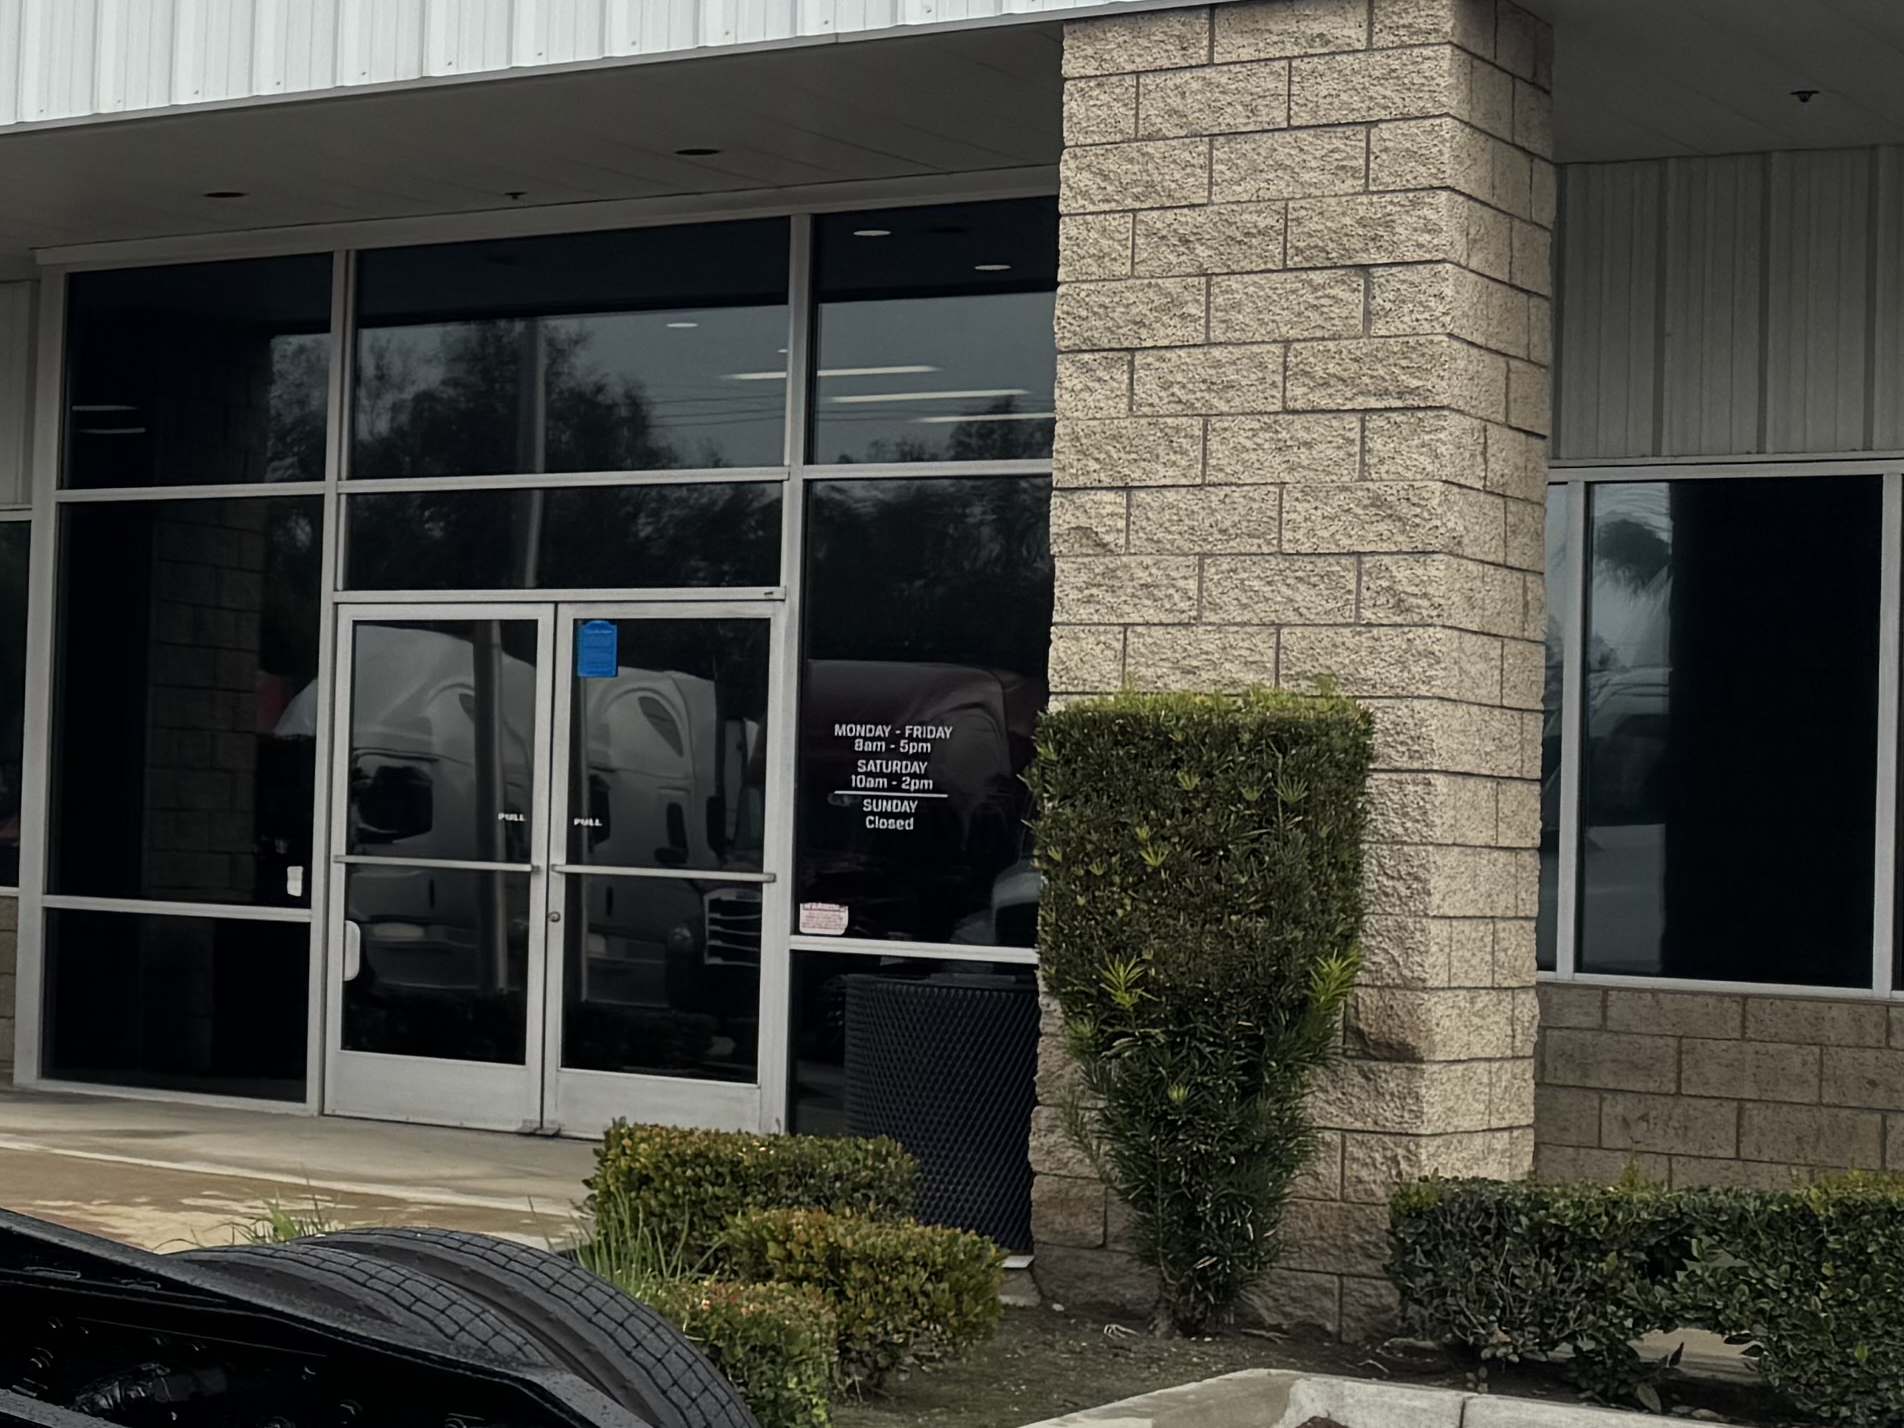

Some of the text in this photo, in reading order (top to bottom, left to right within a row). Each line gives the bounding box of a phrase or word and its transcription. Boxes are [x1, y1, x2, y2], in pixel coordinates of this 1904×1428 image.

[834, 724, 892, 738] MONDAY
[905, 725, 953, 739] FRIDAY
[854, 738, 886, 752] 8am
[899, 739, 932, 755] 5pm
[857, 759, 928, 774] SATURDAY
[852, 775, 888, 789] 10am
[901, 776, 934, 792] 2pm
[863, 798, 918, 813] SUNDAY
[866, 815, 914, 830] Closed
